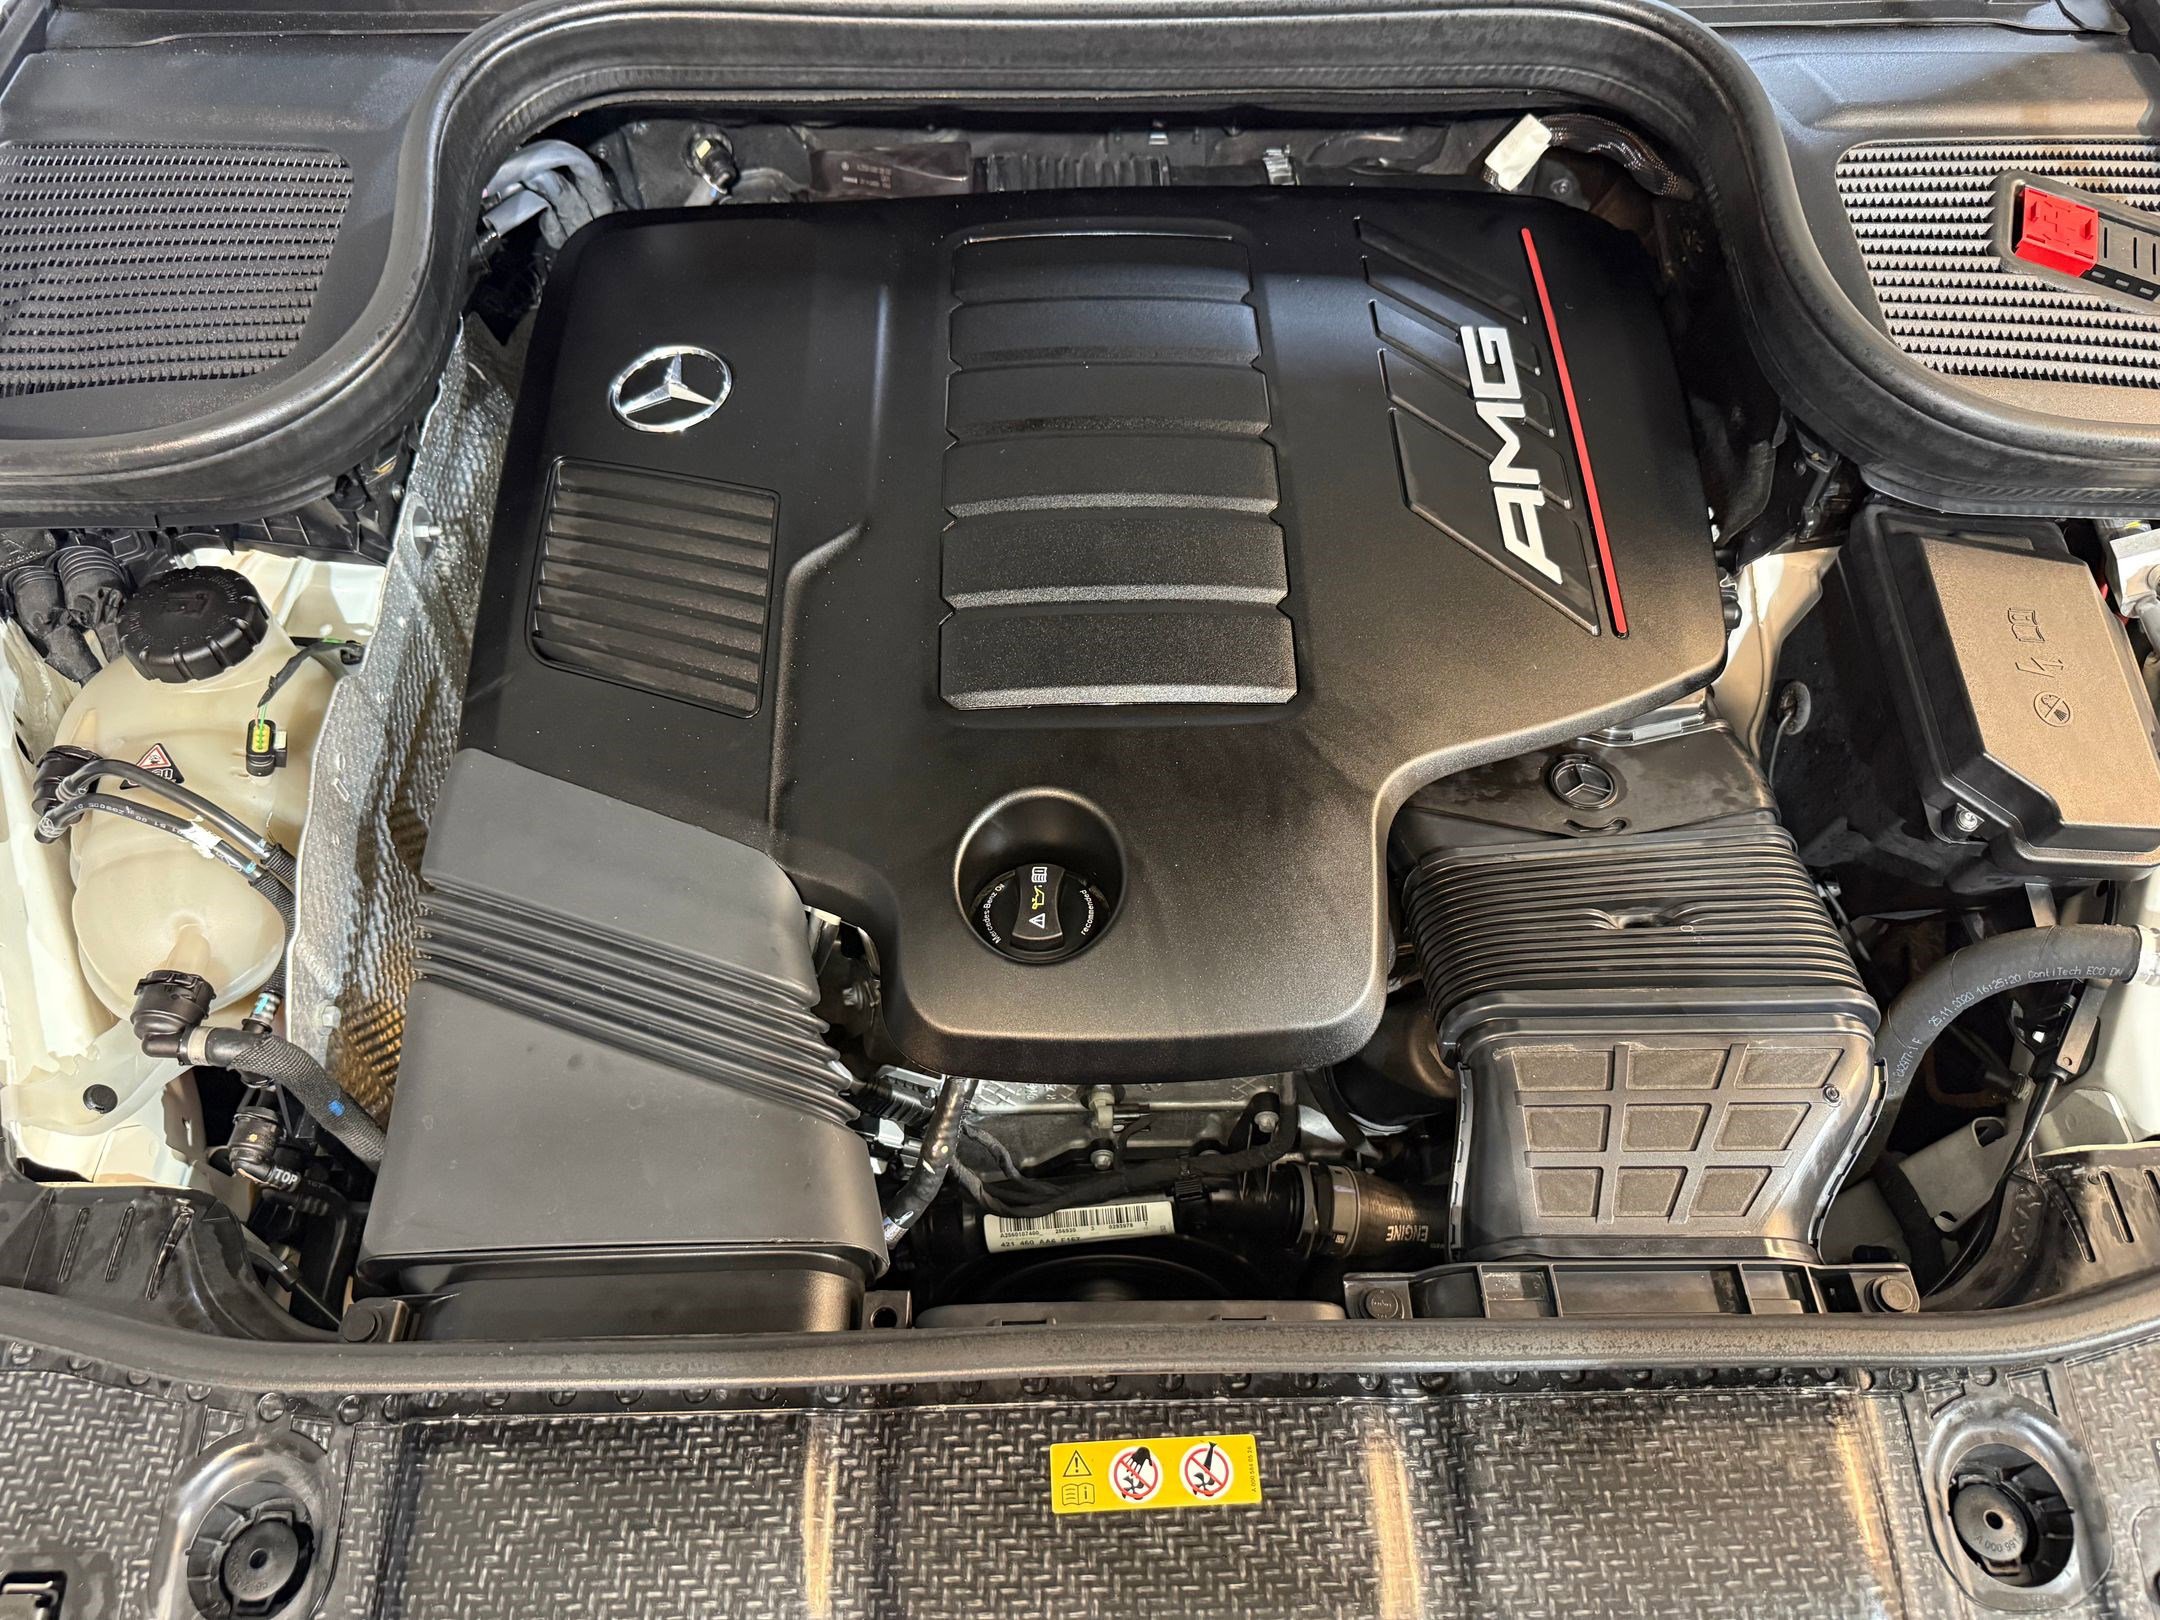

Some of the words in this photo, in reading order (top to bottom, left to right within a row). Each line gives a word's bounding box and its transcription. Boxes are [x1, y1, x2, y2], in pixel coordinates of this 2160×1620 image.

[1460, 325, 1563, 585] AMG
[983, 892, 1002, 944] Mercedes-Benz
[1080, 889, 1095, 935] recommended
[1976, 973, 2022, 995] 16:25:20
[274, 1168, 298, 1185] TOP
[1385, 1225, 1429, 1242] ENGINE
